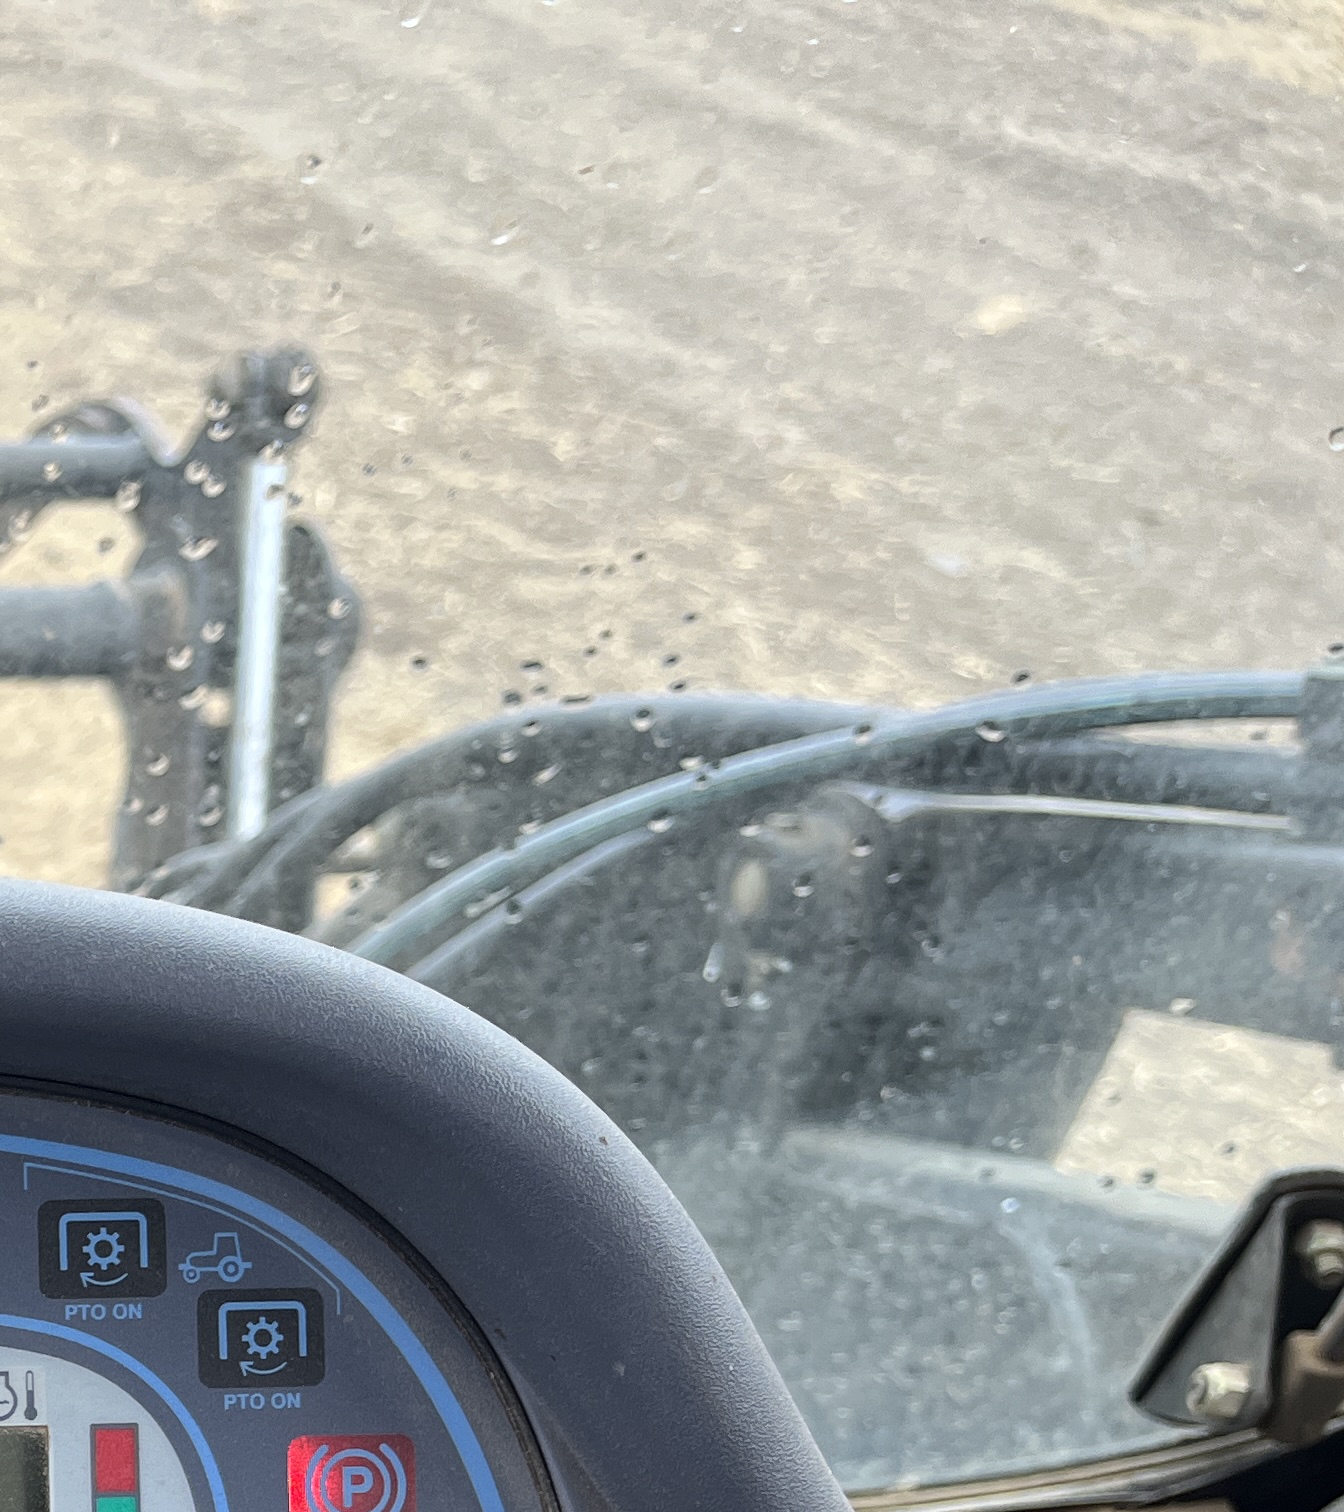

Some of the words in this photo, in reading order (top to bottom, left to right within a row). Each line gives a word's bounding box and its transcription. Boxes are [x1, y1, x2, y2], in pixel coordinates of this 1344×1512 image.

[65, 1304, 107, 1321] PTO
[112, 1303, 142, 1320] ON
[224, 1393, 266, 1411] PTO
[271, 1393, 301, 1410] ON
